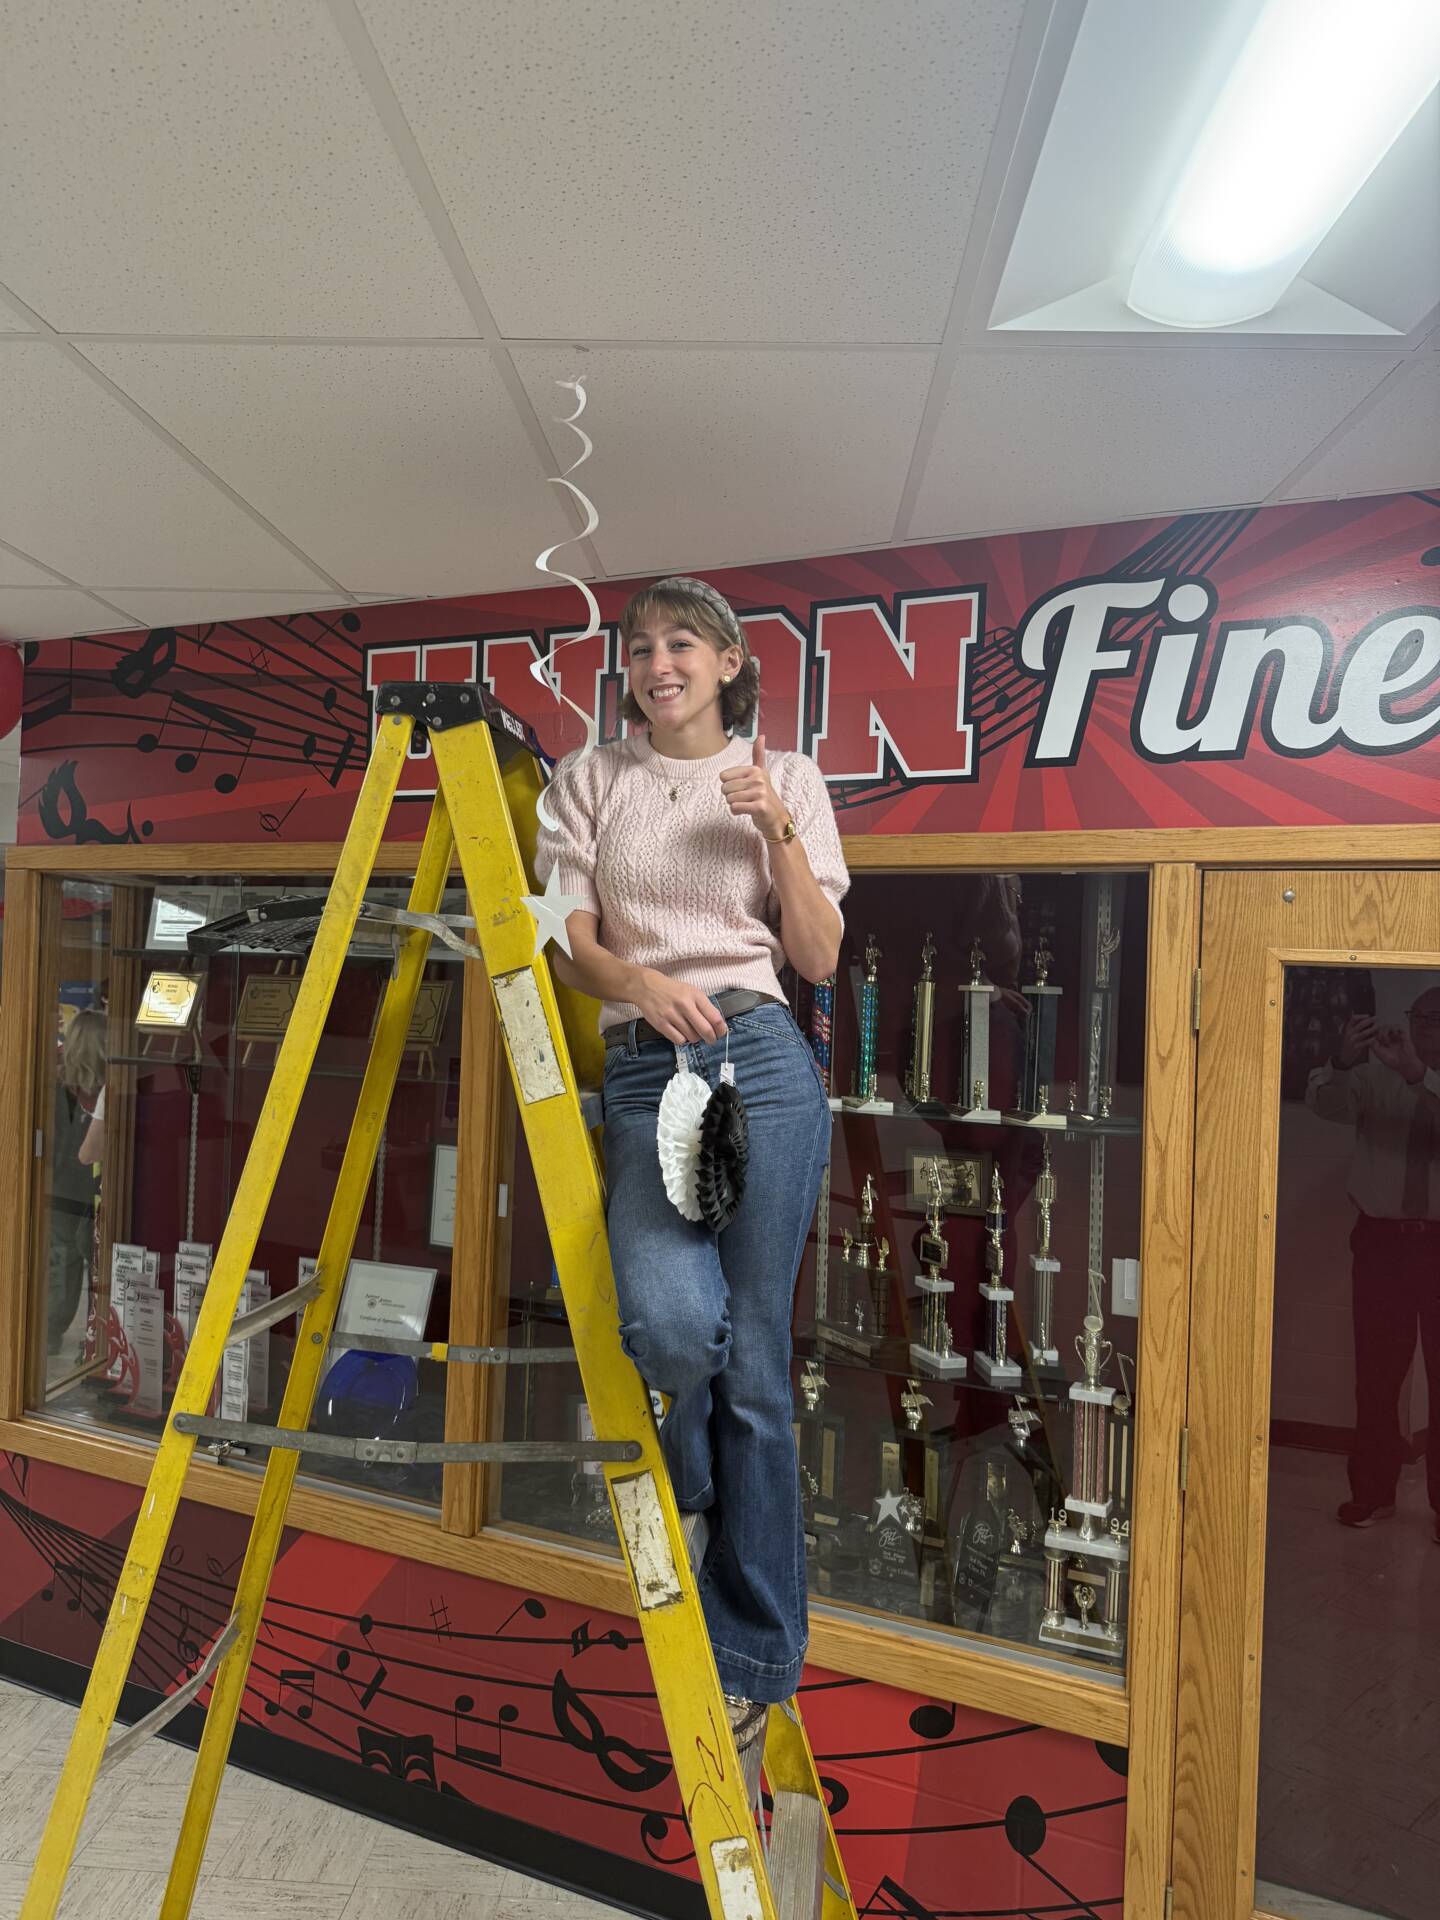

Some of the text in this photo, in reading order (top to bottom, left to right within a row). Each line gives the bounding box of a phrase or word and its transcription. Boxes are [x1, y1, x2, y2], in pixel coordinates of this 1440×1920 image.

[363, 574, 1440, 801] UNON Fine
[1049, 1507, 1130, 1536] 19 94
